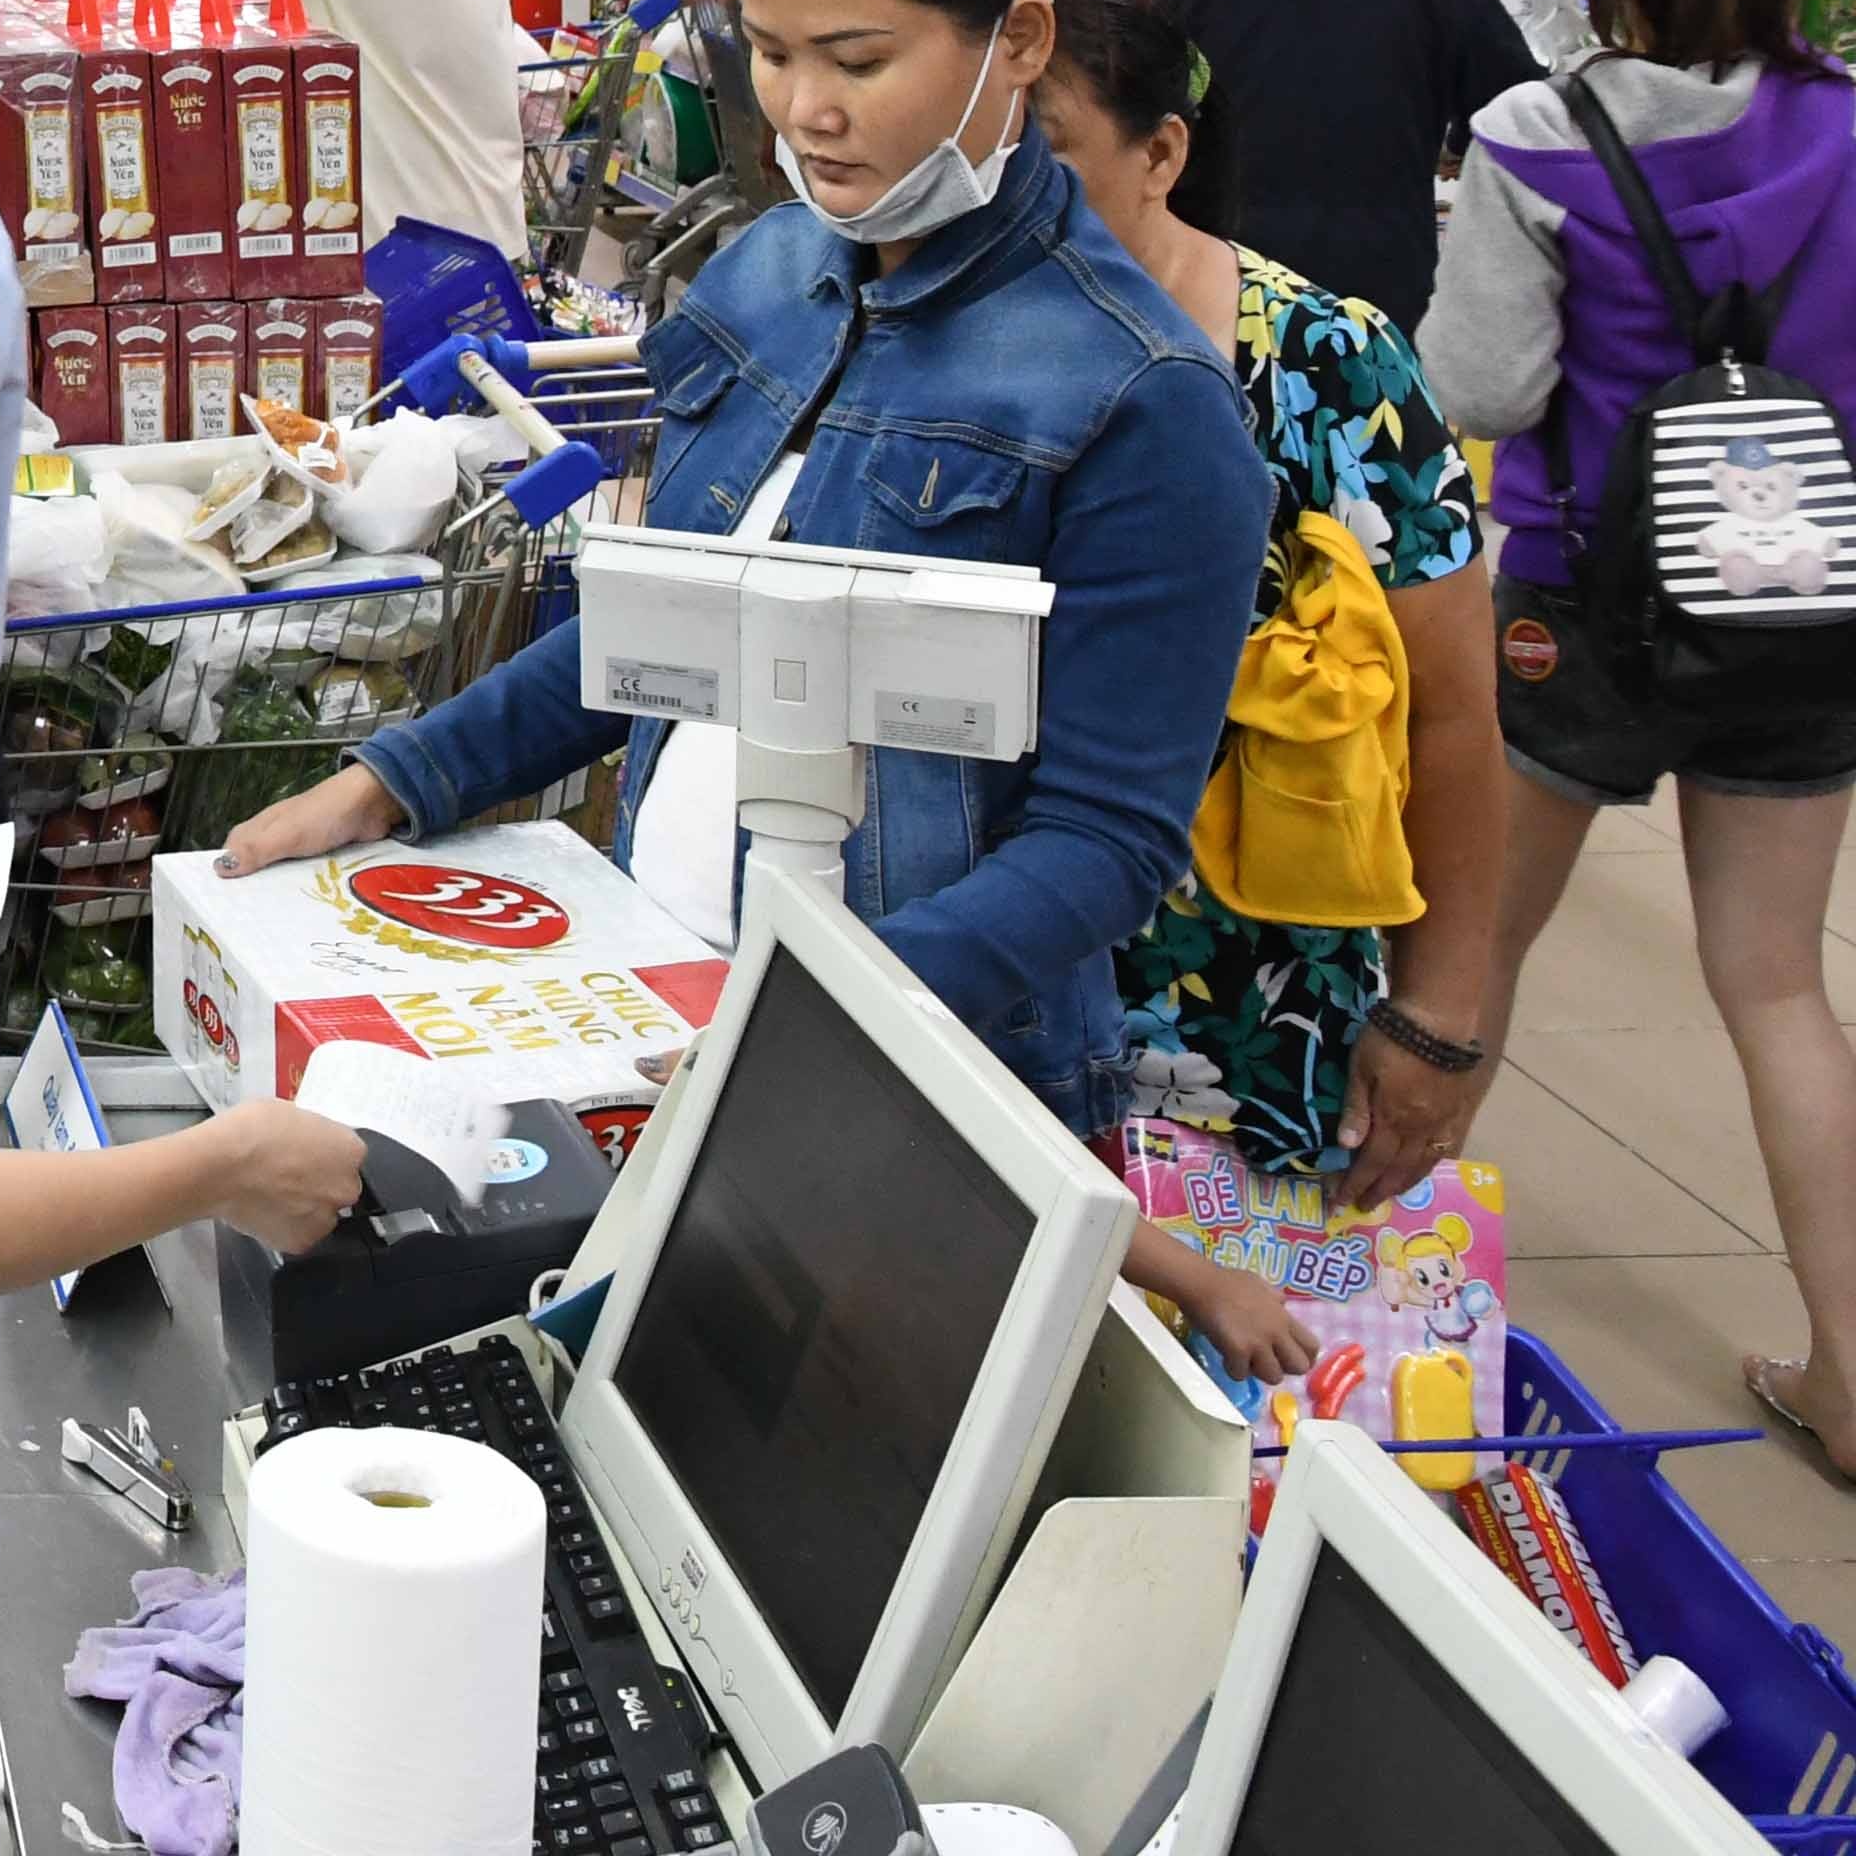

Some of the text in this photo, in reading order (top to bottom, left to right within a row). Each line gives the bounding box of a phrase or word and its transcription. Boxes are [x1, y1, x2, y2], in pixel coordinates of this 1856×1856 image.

[173, 109, 202, 126] Yến
[378, 875, 563, 930] 333
[1186, 1159, 1245, 1226] BÉ
[1469, 1167, 1496, 1188] 3+
[1289, 1240, 1375, 1304] BẾP
[616, 1687, 654, 1732] DELL
